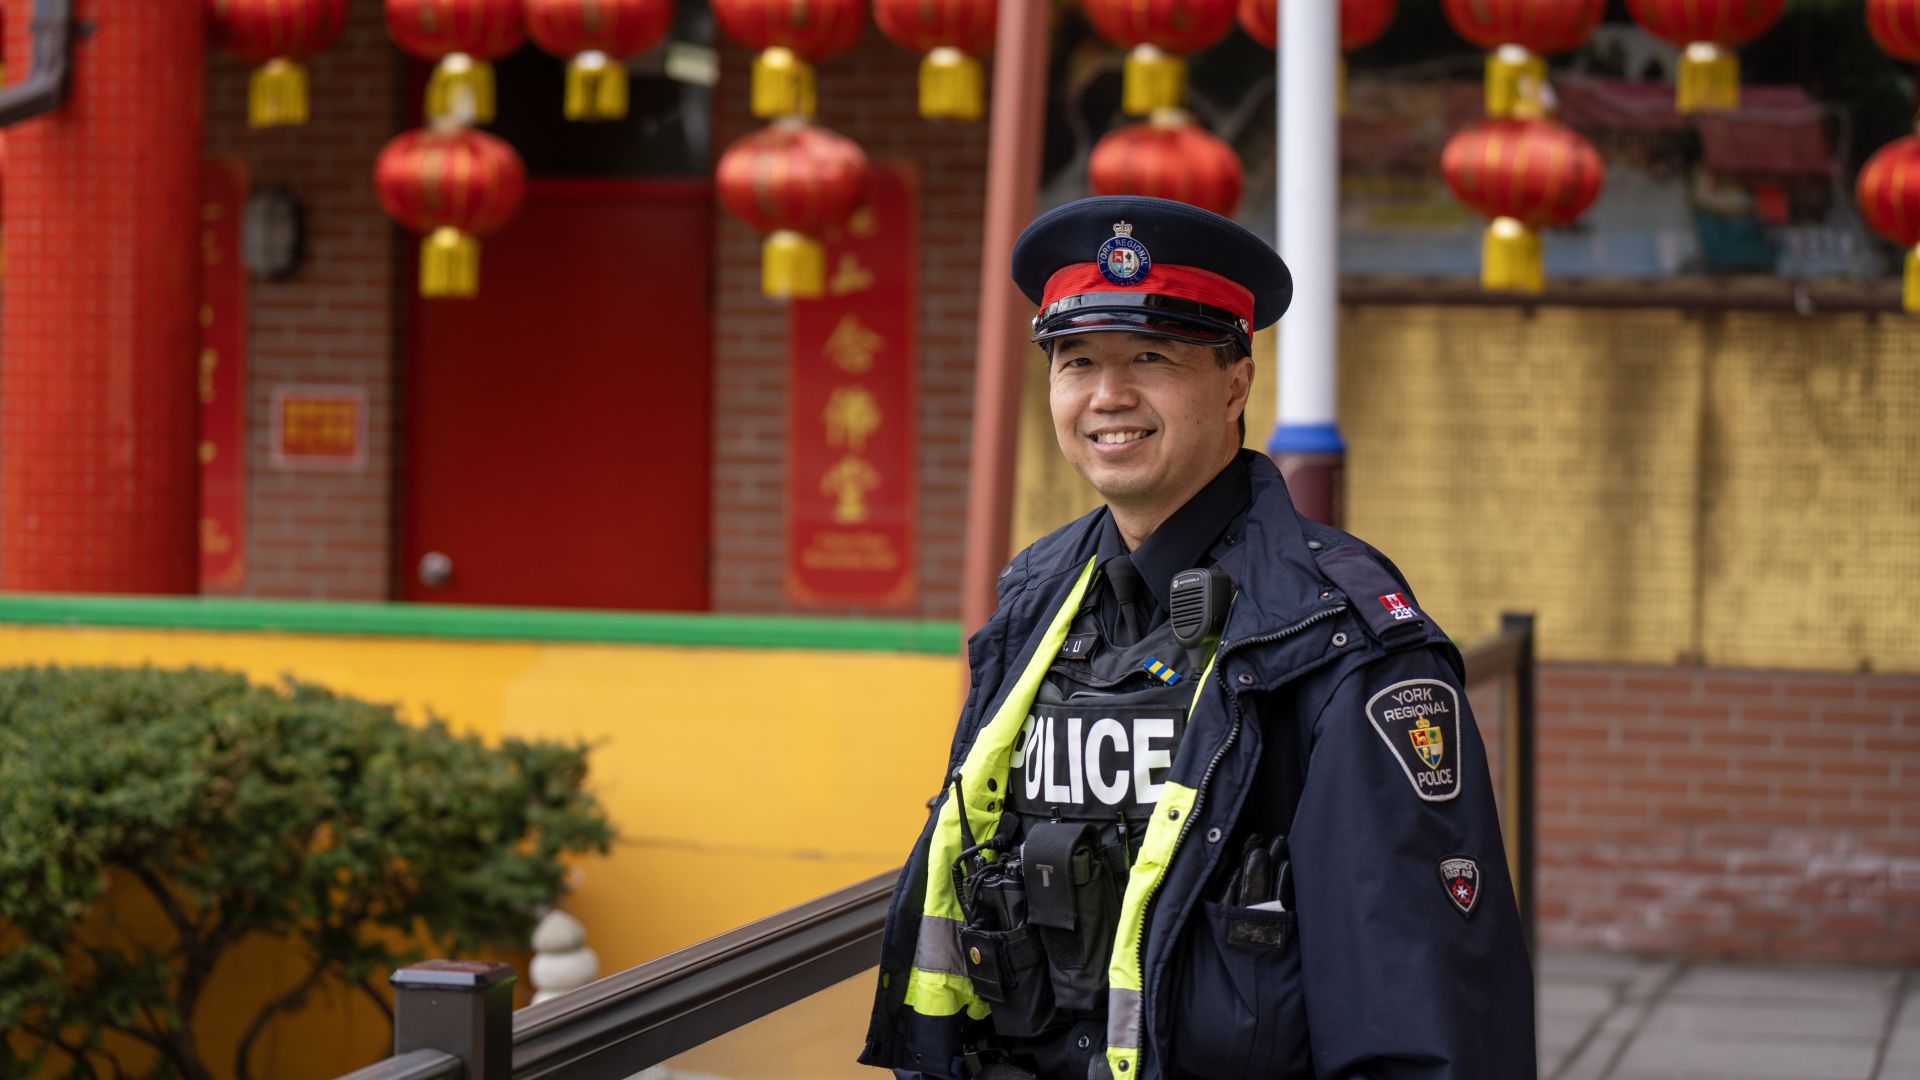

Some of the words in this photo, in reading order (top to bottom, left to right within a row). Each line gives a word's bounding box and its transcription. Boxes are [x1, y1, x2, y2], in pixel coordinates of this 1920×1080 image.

[1099, 243, 1114, 265] YORK
[1115, 239, 1149, 266] REGIONAL
[1390, 606, 1418, 620] 2291
[1391, 687, 1433, 706] YORK
[1383, 701, 1449, 722] REGIONAL
[1417, 768, 1453, 787] POLICE
